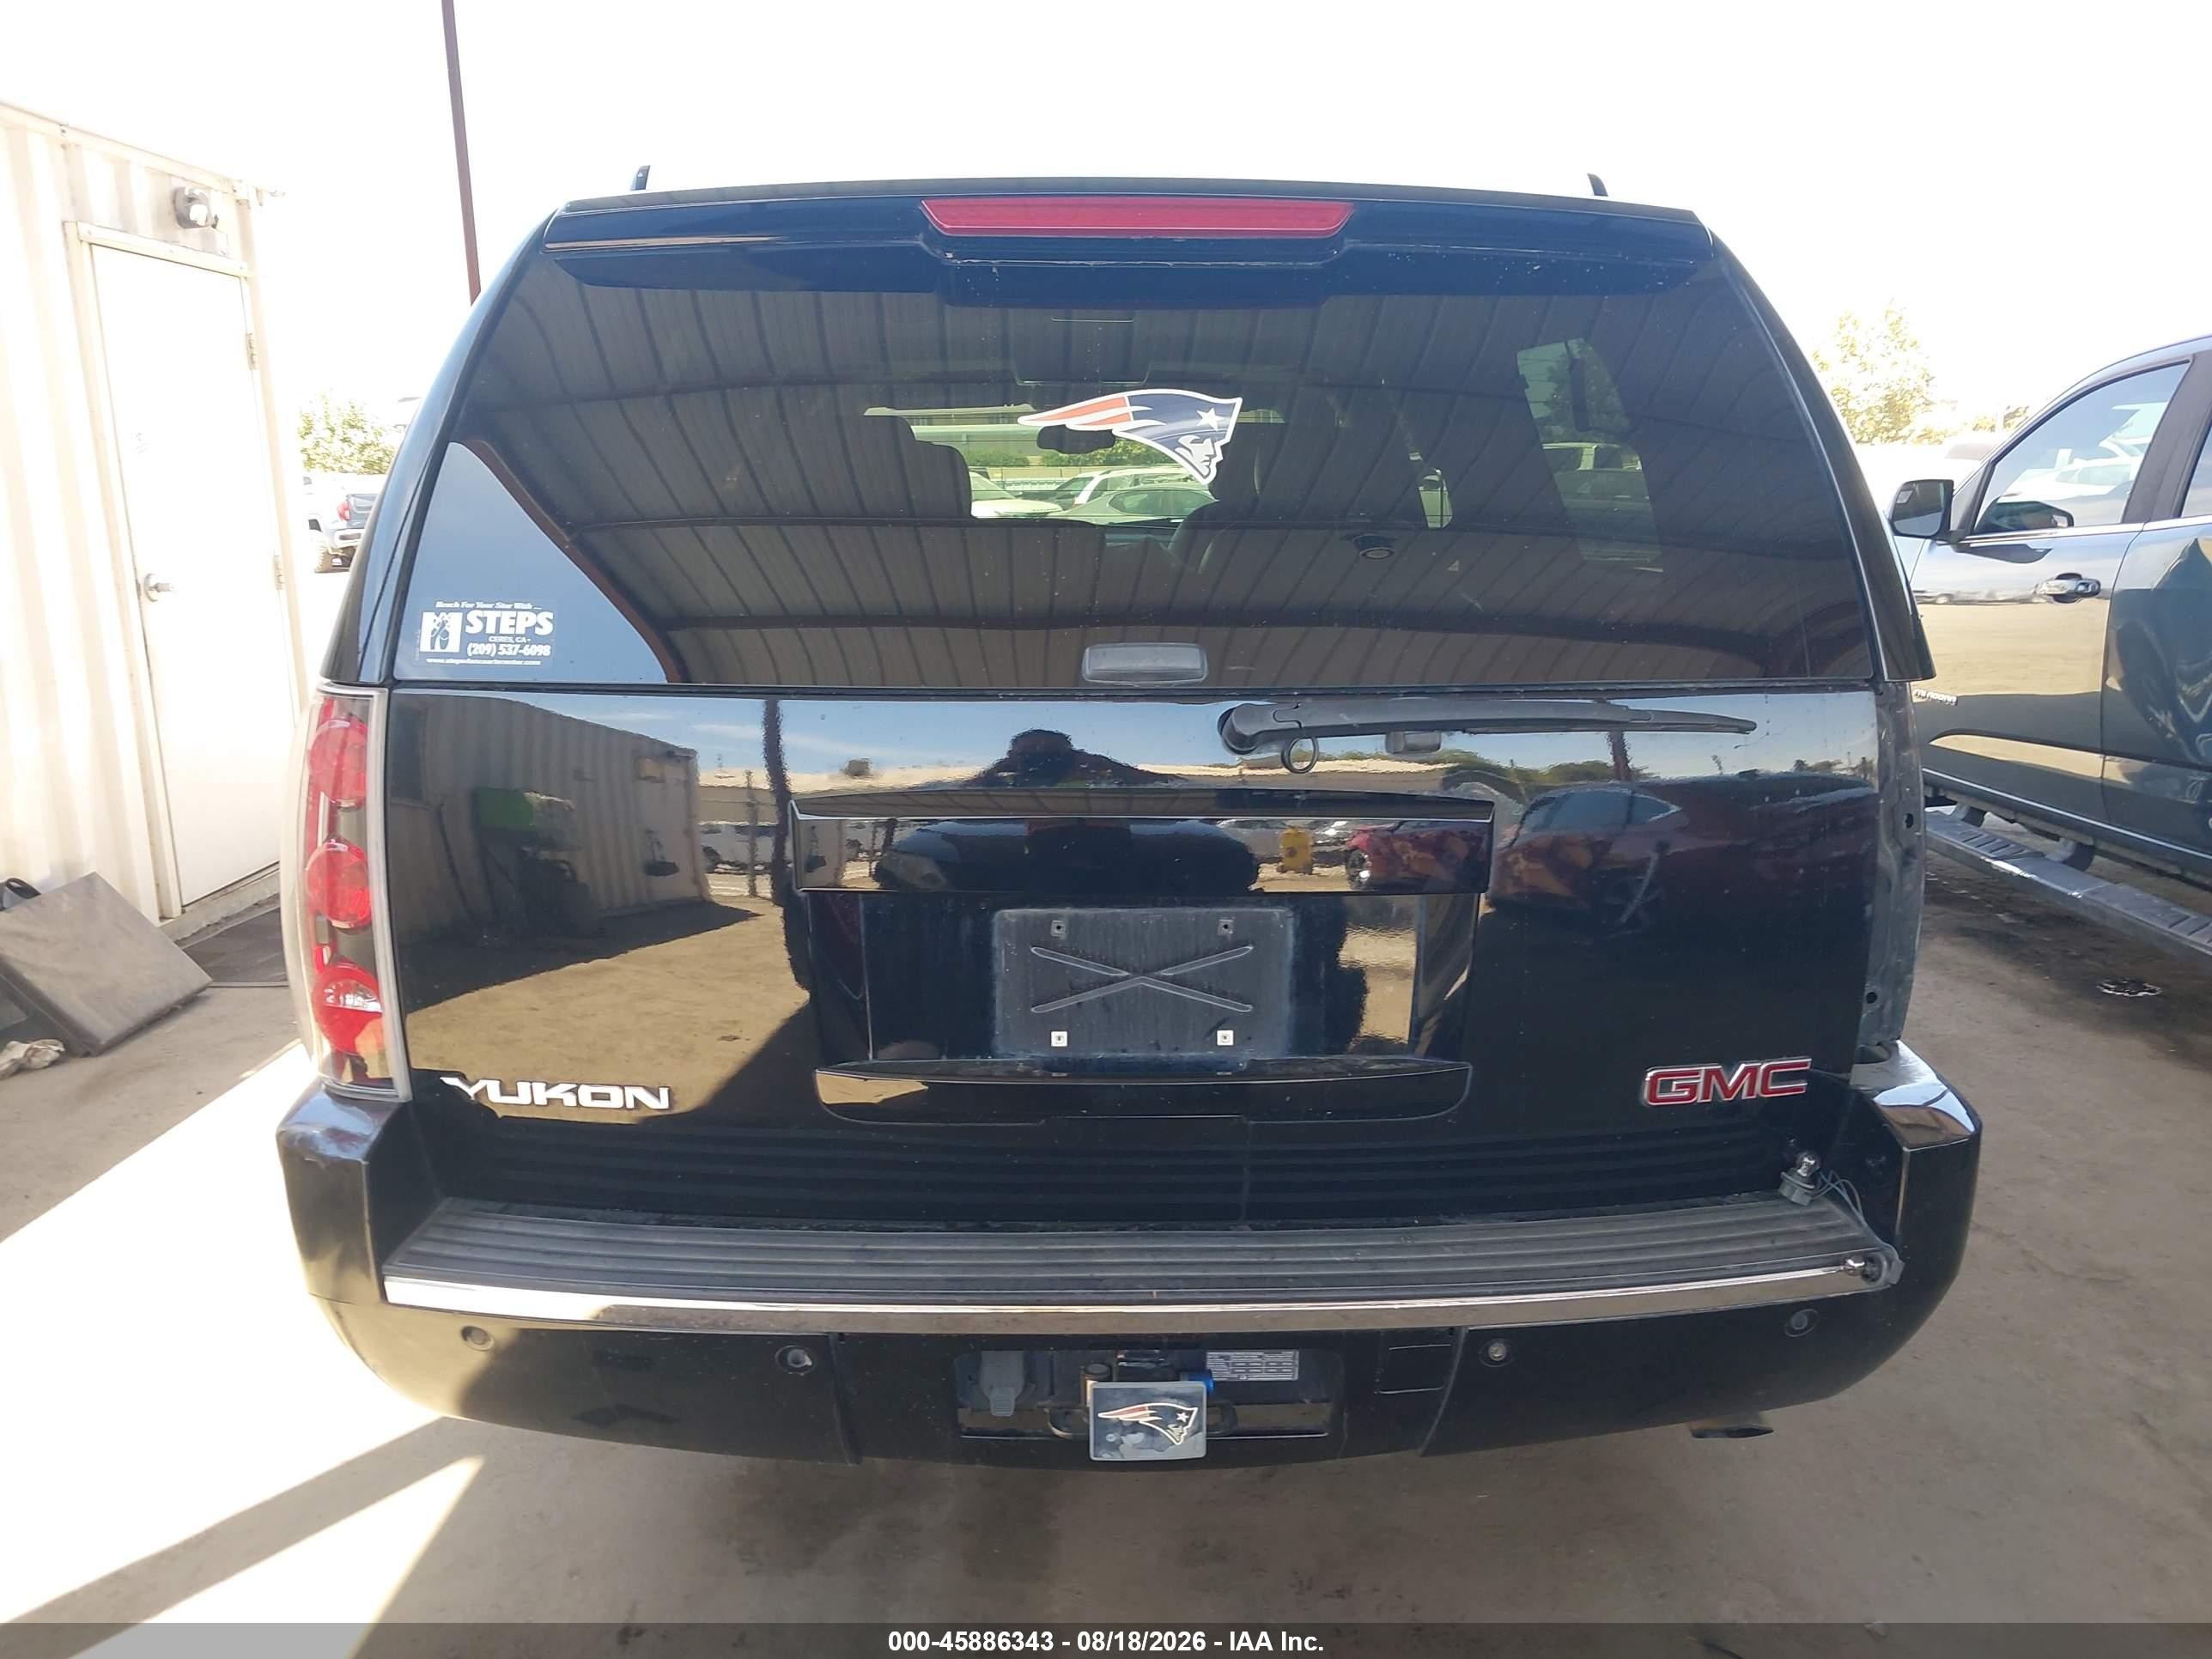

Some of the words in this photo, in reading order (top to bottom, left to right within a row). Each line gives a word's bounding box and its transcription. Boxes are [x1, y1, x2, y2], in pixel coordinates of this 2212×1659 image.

[465, 610, 554, 635] STEPS
[466, 643, 496, 657] (209)
[497, 644, 551, 657] 537-6098
[439, 1076, 671, 1110] YUKON
[1643, 1056, 1813, 1106] GMC
